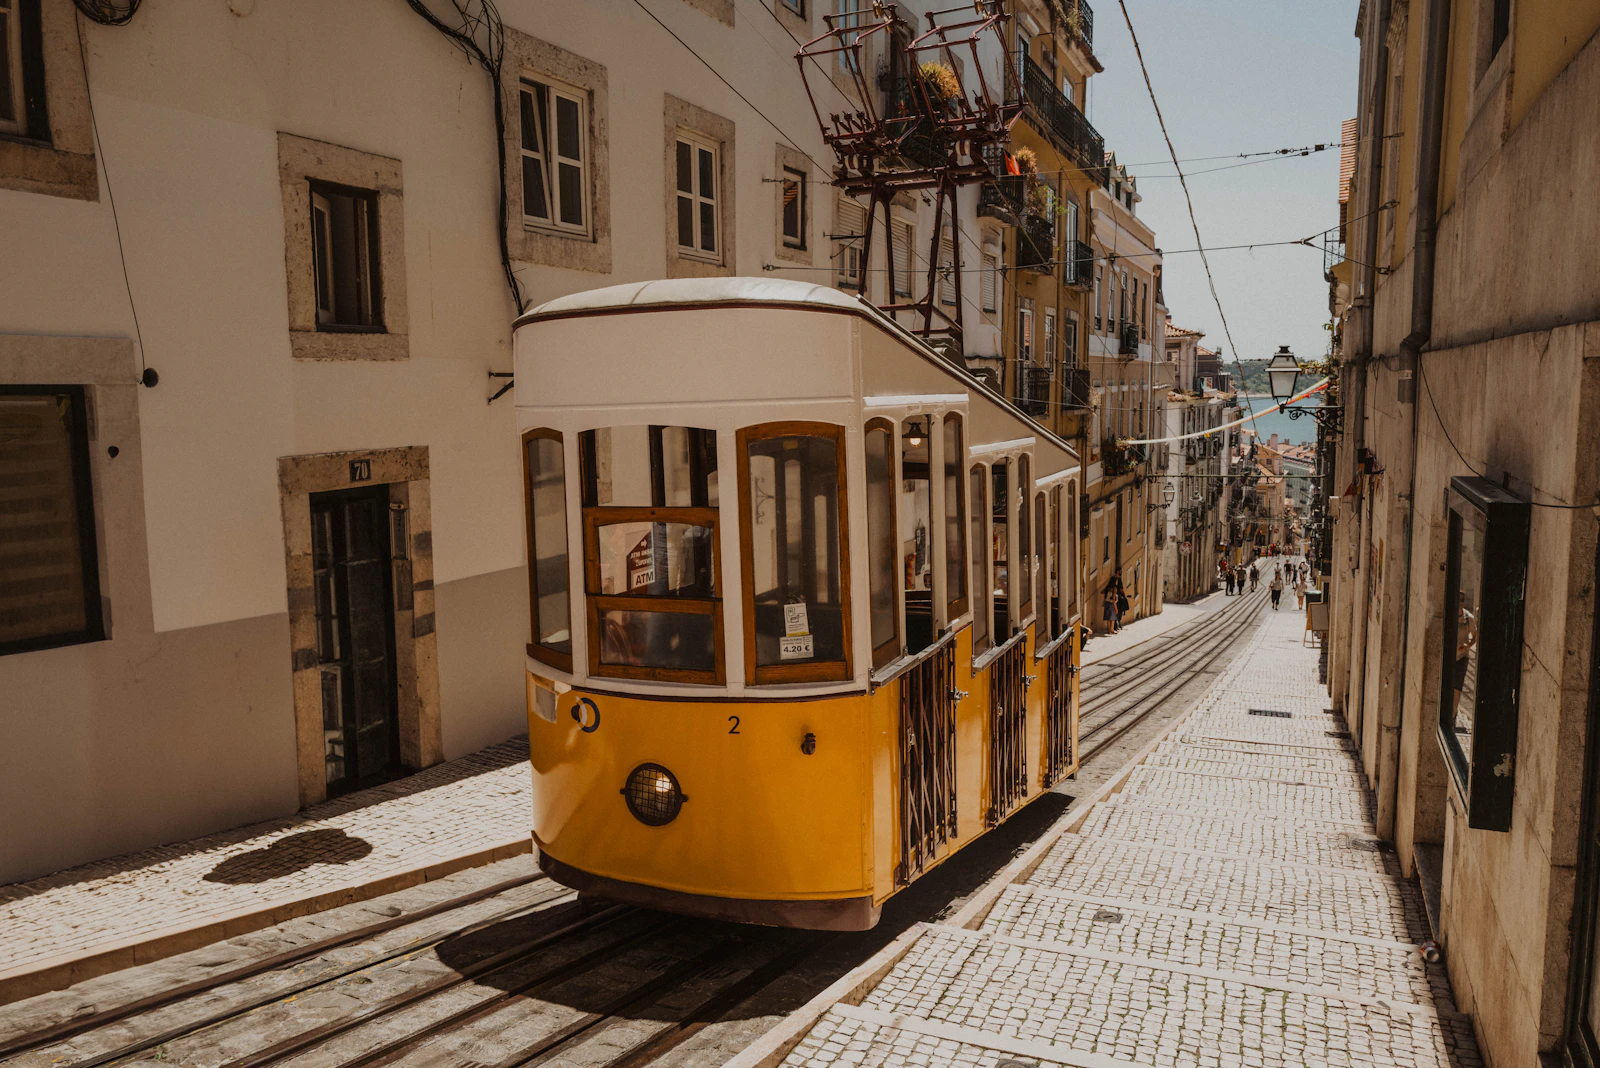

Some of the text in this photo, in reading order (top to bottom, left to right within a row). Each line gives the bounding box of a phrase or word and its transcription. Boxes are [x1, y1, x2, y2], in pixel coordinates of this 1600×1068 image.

[354, 462, 368, 480] 70
[635, 571, 654, 586] ATM
[783, 645, 802, 653] 4.20
[728, 715, 741, 735] 2
